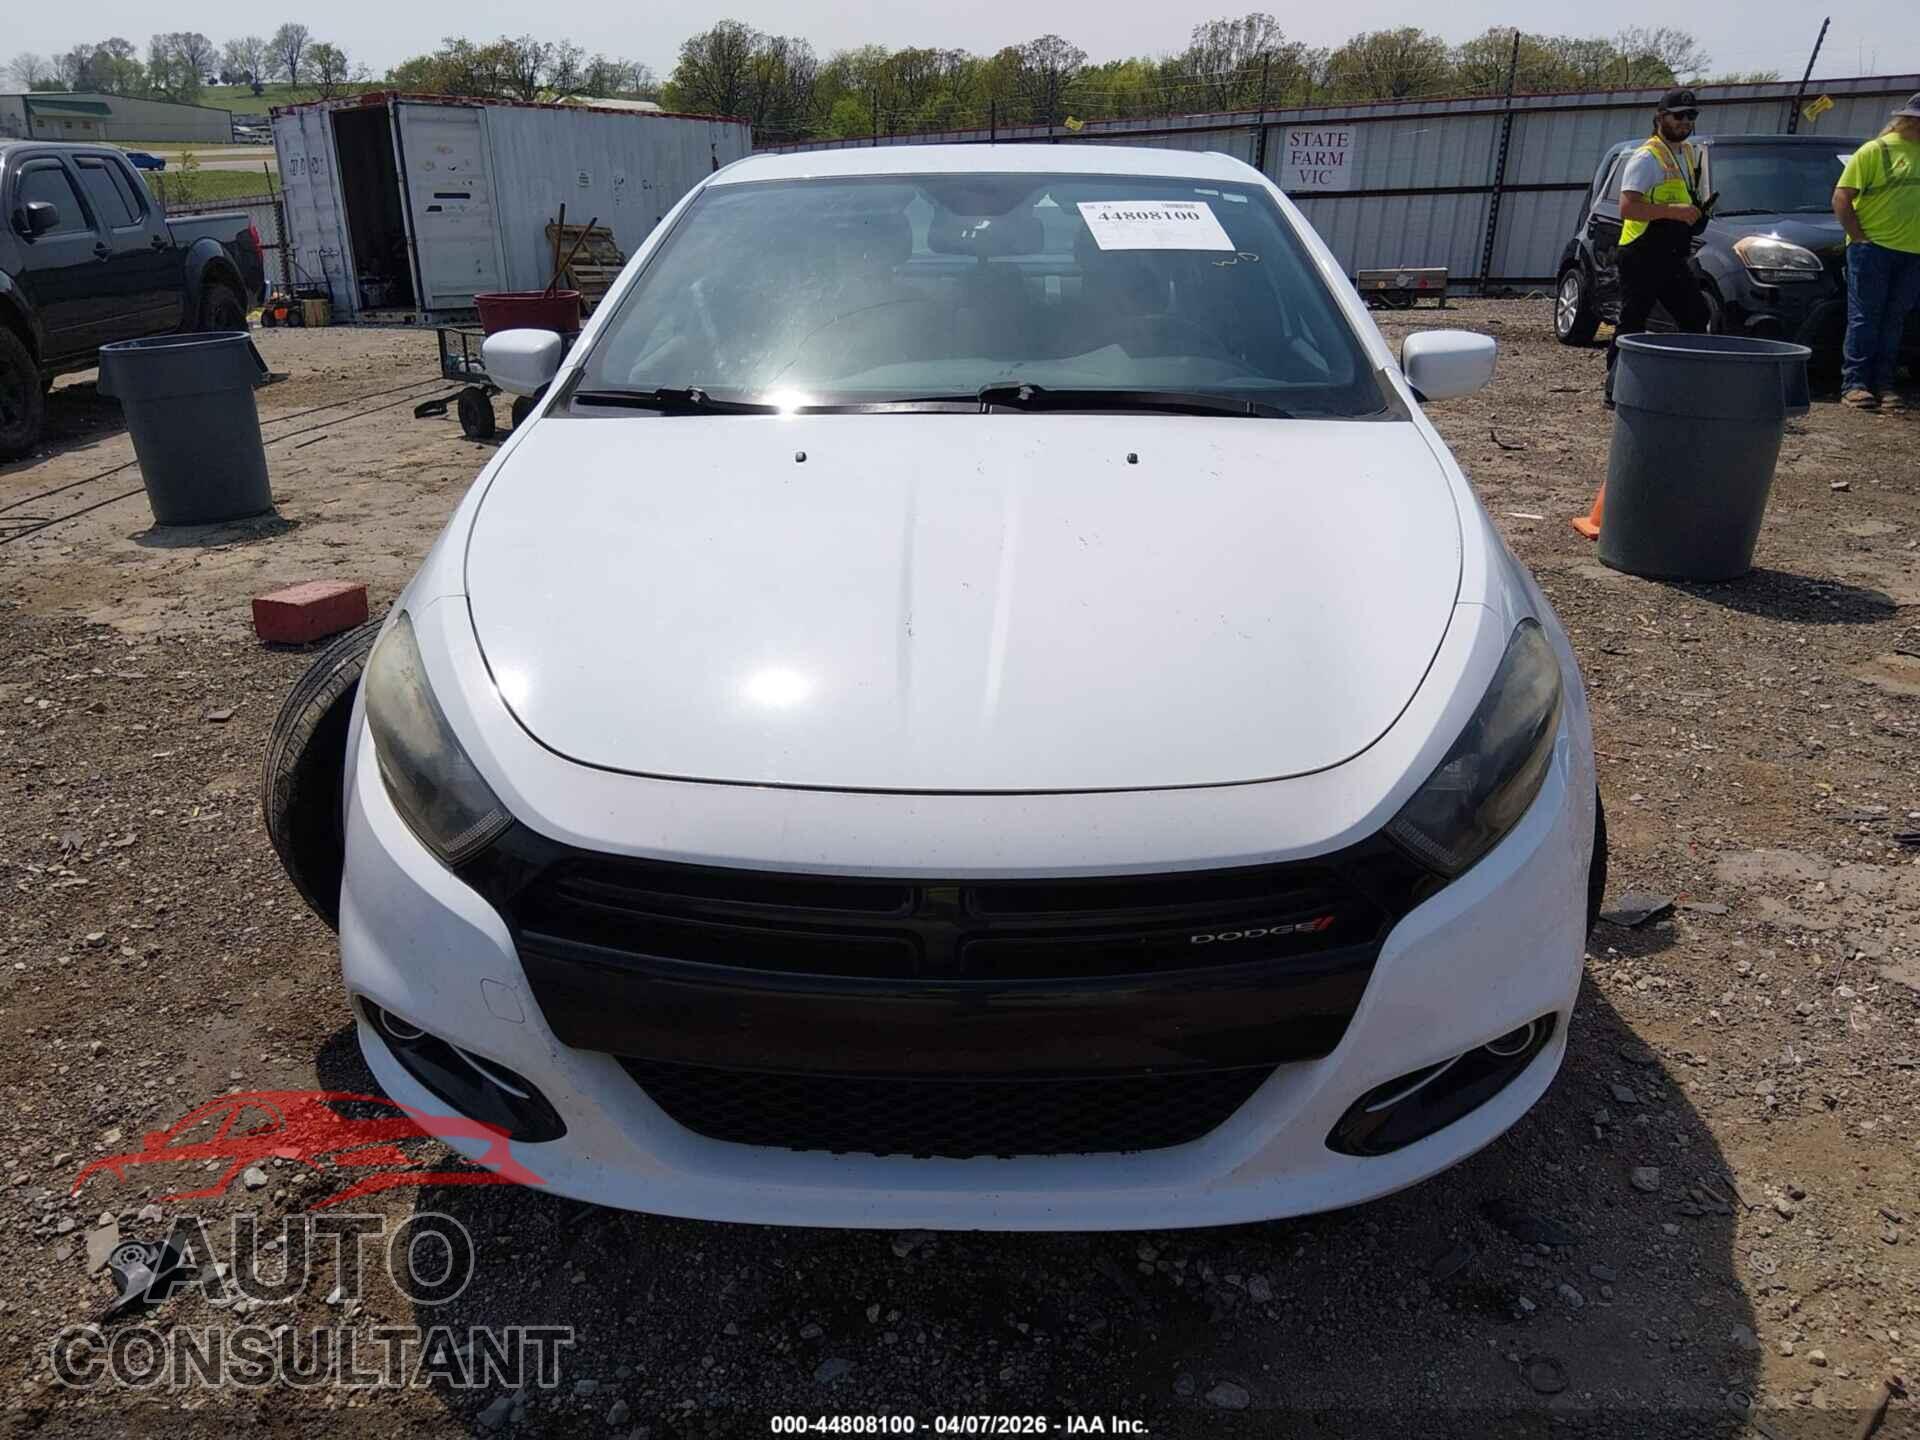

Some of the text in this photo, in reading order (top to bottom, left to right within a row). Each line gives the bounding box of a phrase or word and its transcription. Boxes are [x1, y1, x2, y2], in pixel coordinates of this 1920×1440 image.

[1290, 132, 1349, 147] STATE
[1291, 151, 1344, 166] FARM
[1299, 169, 1333, 185] VIC
[1098, 211, 1200, 221] 44808100
[1191, 921, 1315, 944] DODGE
